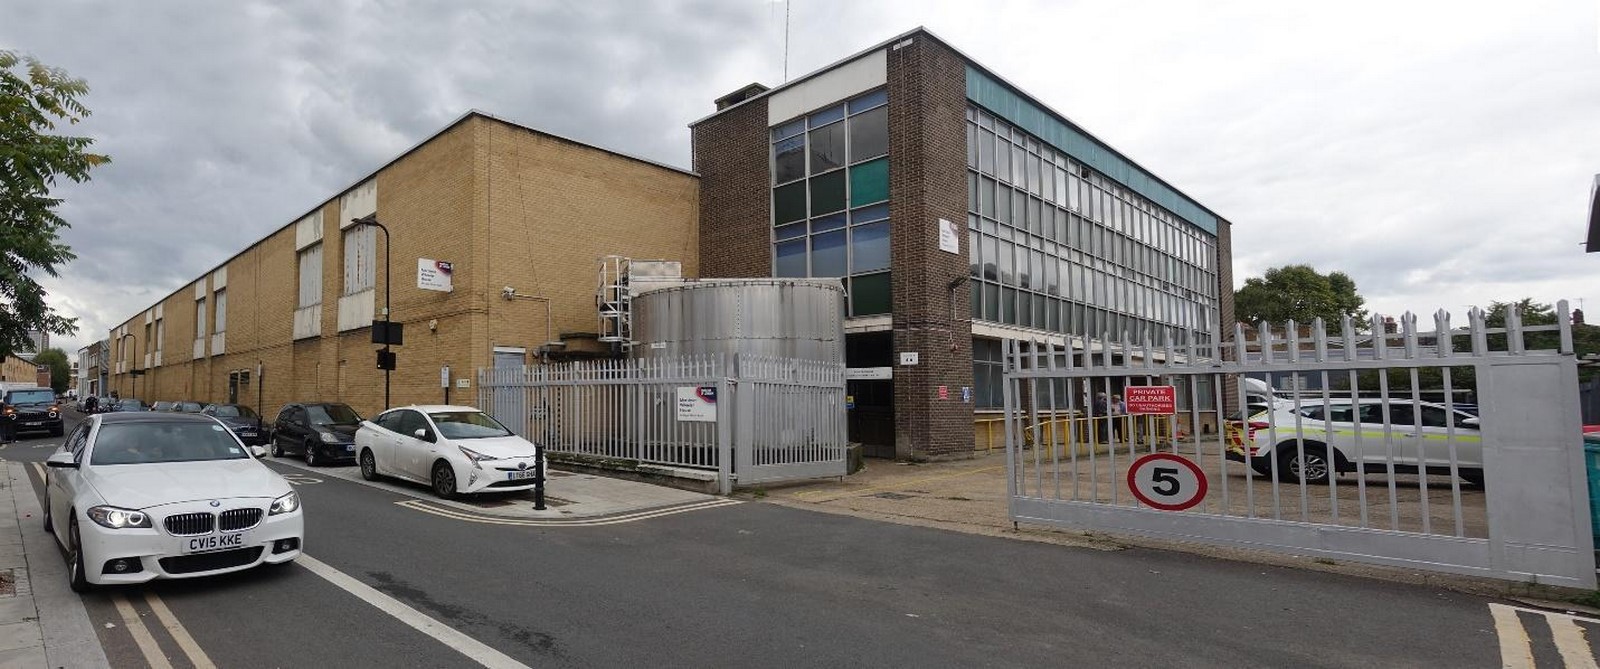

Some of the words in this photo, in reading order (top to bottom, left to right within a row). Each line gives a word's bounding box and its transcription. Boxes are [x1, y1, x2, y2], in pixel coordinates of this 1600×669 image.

[1152, 467, 1180, 496] 5
[190, 536, 217, 550] CV15
[219, 533, 242, 547] KKE
